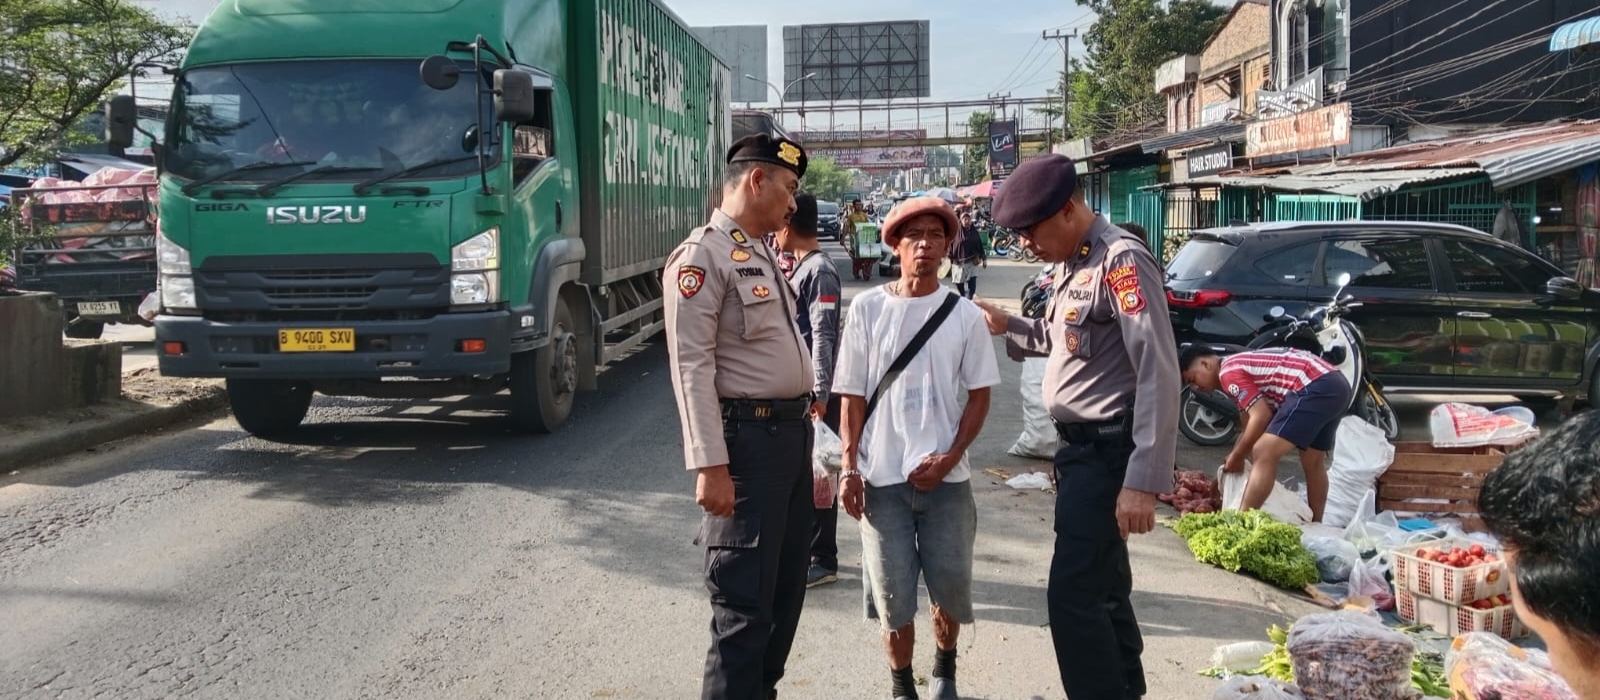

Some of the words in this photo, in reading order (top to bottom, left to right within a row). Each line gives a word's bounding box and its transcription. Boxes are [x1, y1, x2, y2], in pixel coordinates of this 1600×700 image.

[1190, 156, 1204, 173] HAIR
[1205, 151, 1228, 170] STUDIO
[195, 203, 249, 211] GIGA
[392, 200, 443, 209] FTR
[266, 205, 367, 224] ISUZU
[1117, 280, 1133, 291] RIAU
[1068, 289, 1092, 301] POLRI
[280, 331, 288, 344] B
[294, 331, 324, 344] 9400
[329, 331, 352, 344] SXV
